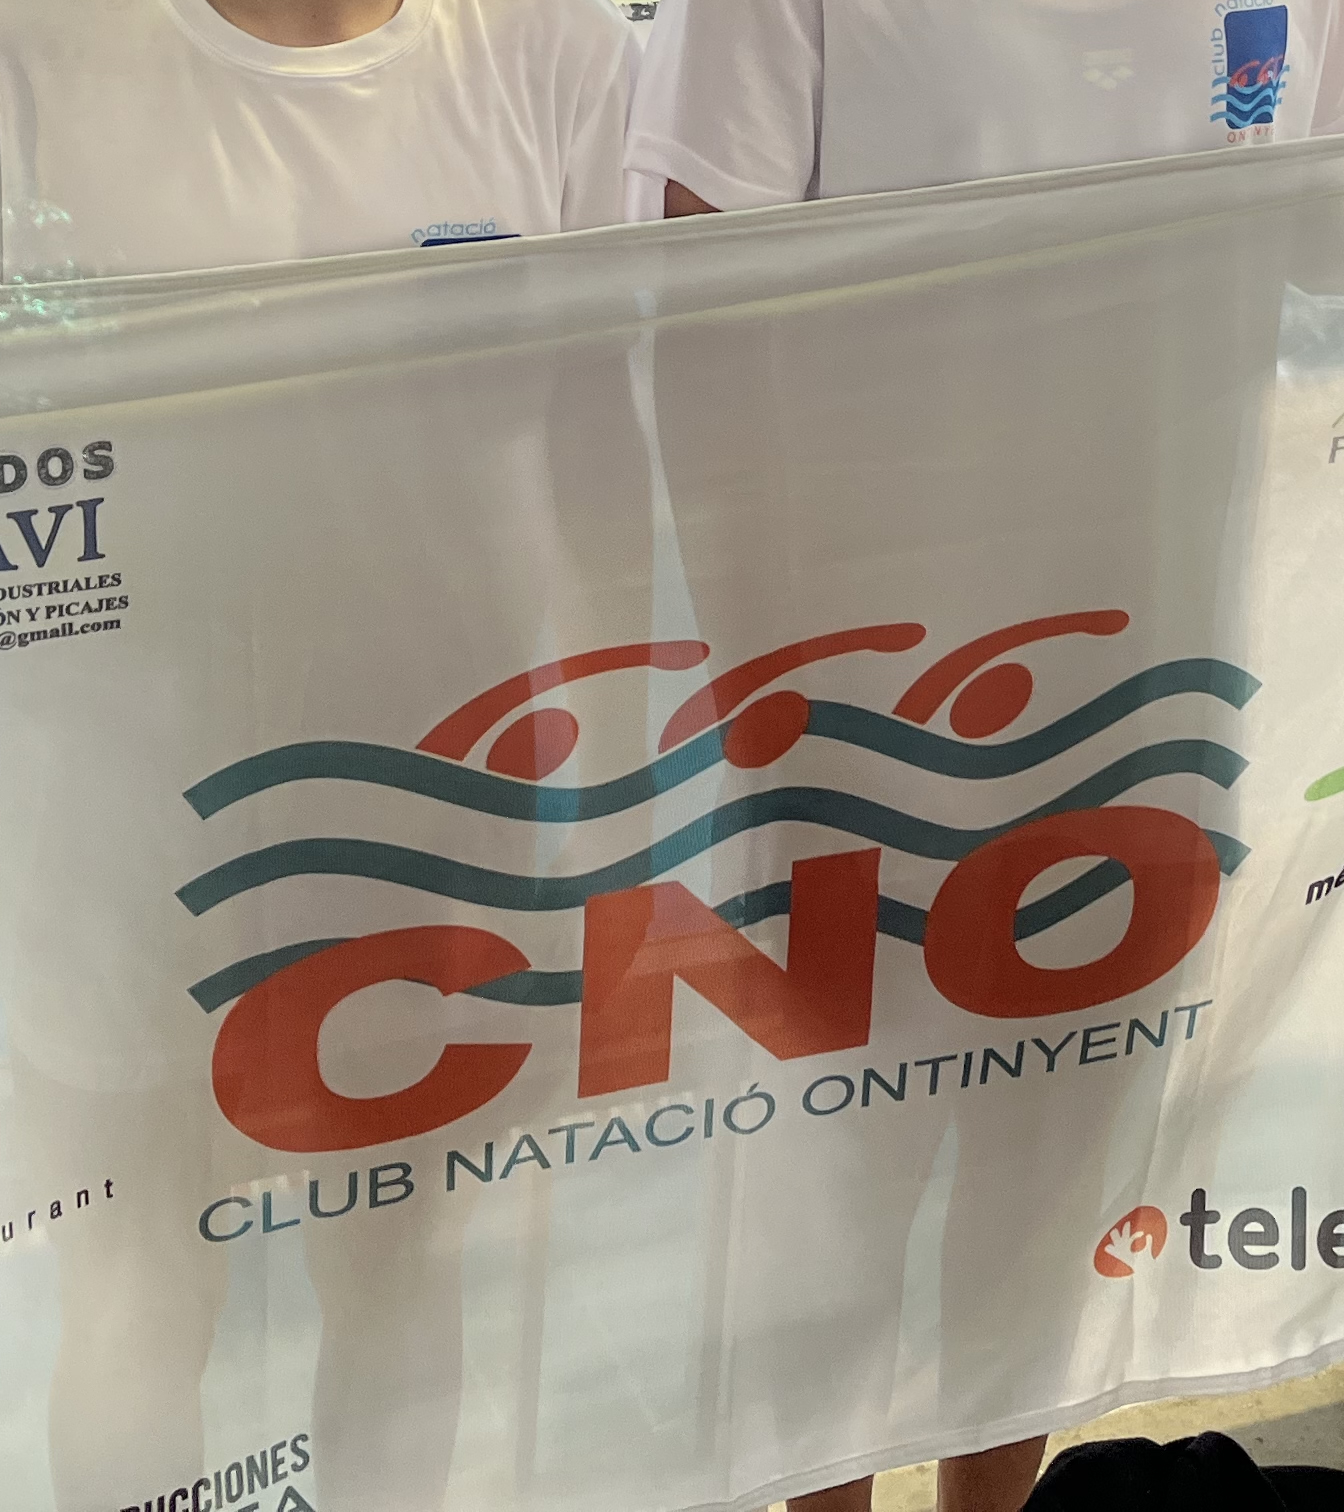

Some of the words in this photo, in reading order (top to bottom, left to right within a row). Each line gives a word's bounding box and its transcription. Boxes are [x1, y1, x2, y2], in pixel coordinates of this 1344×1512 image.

[410, 217, 496, 244] natació
[26, 606, 41, 622] Y
[45, 594, 130, 619] PICAJES
[210, 805, 1222, 1154] CNO
[197, 1161, 416, 1243] CLUB
[444, 1083, 778, 1194] NATACIÓ
[802, 1000, 1214, 1117] ONTINYENT
